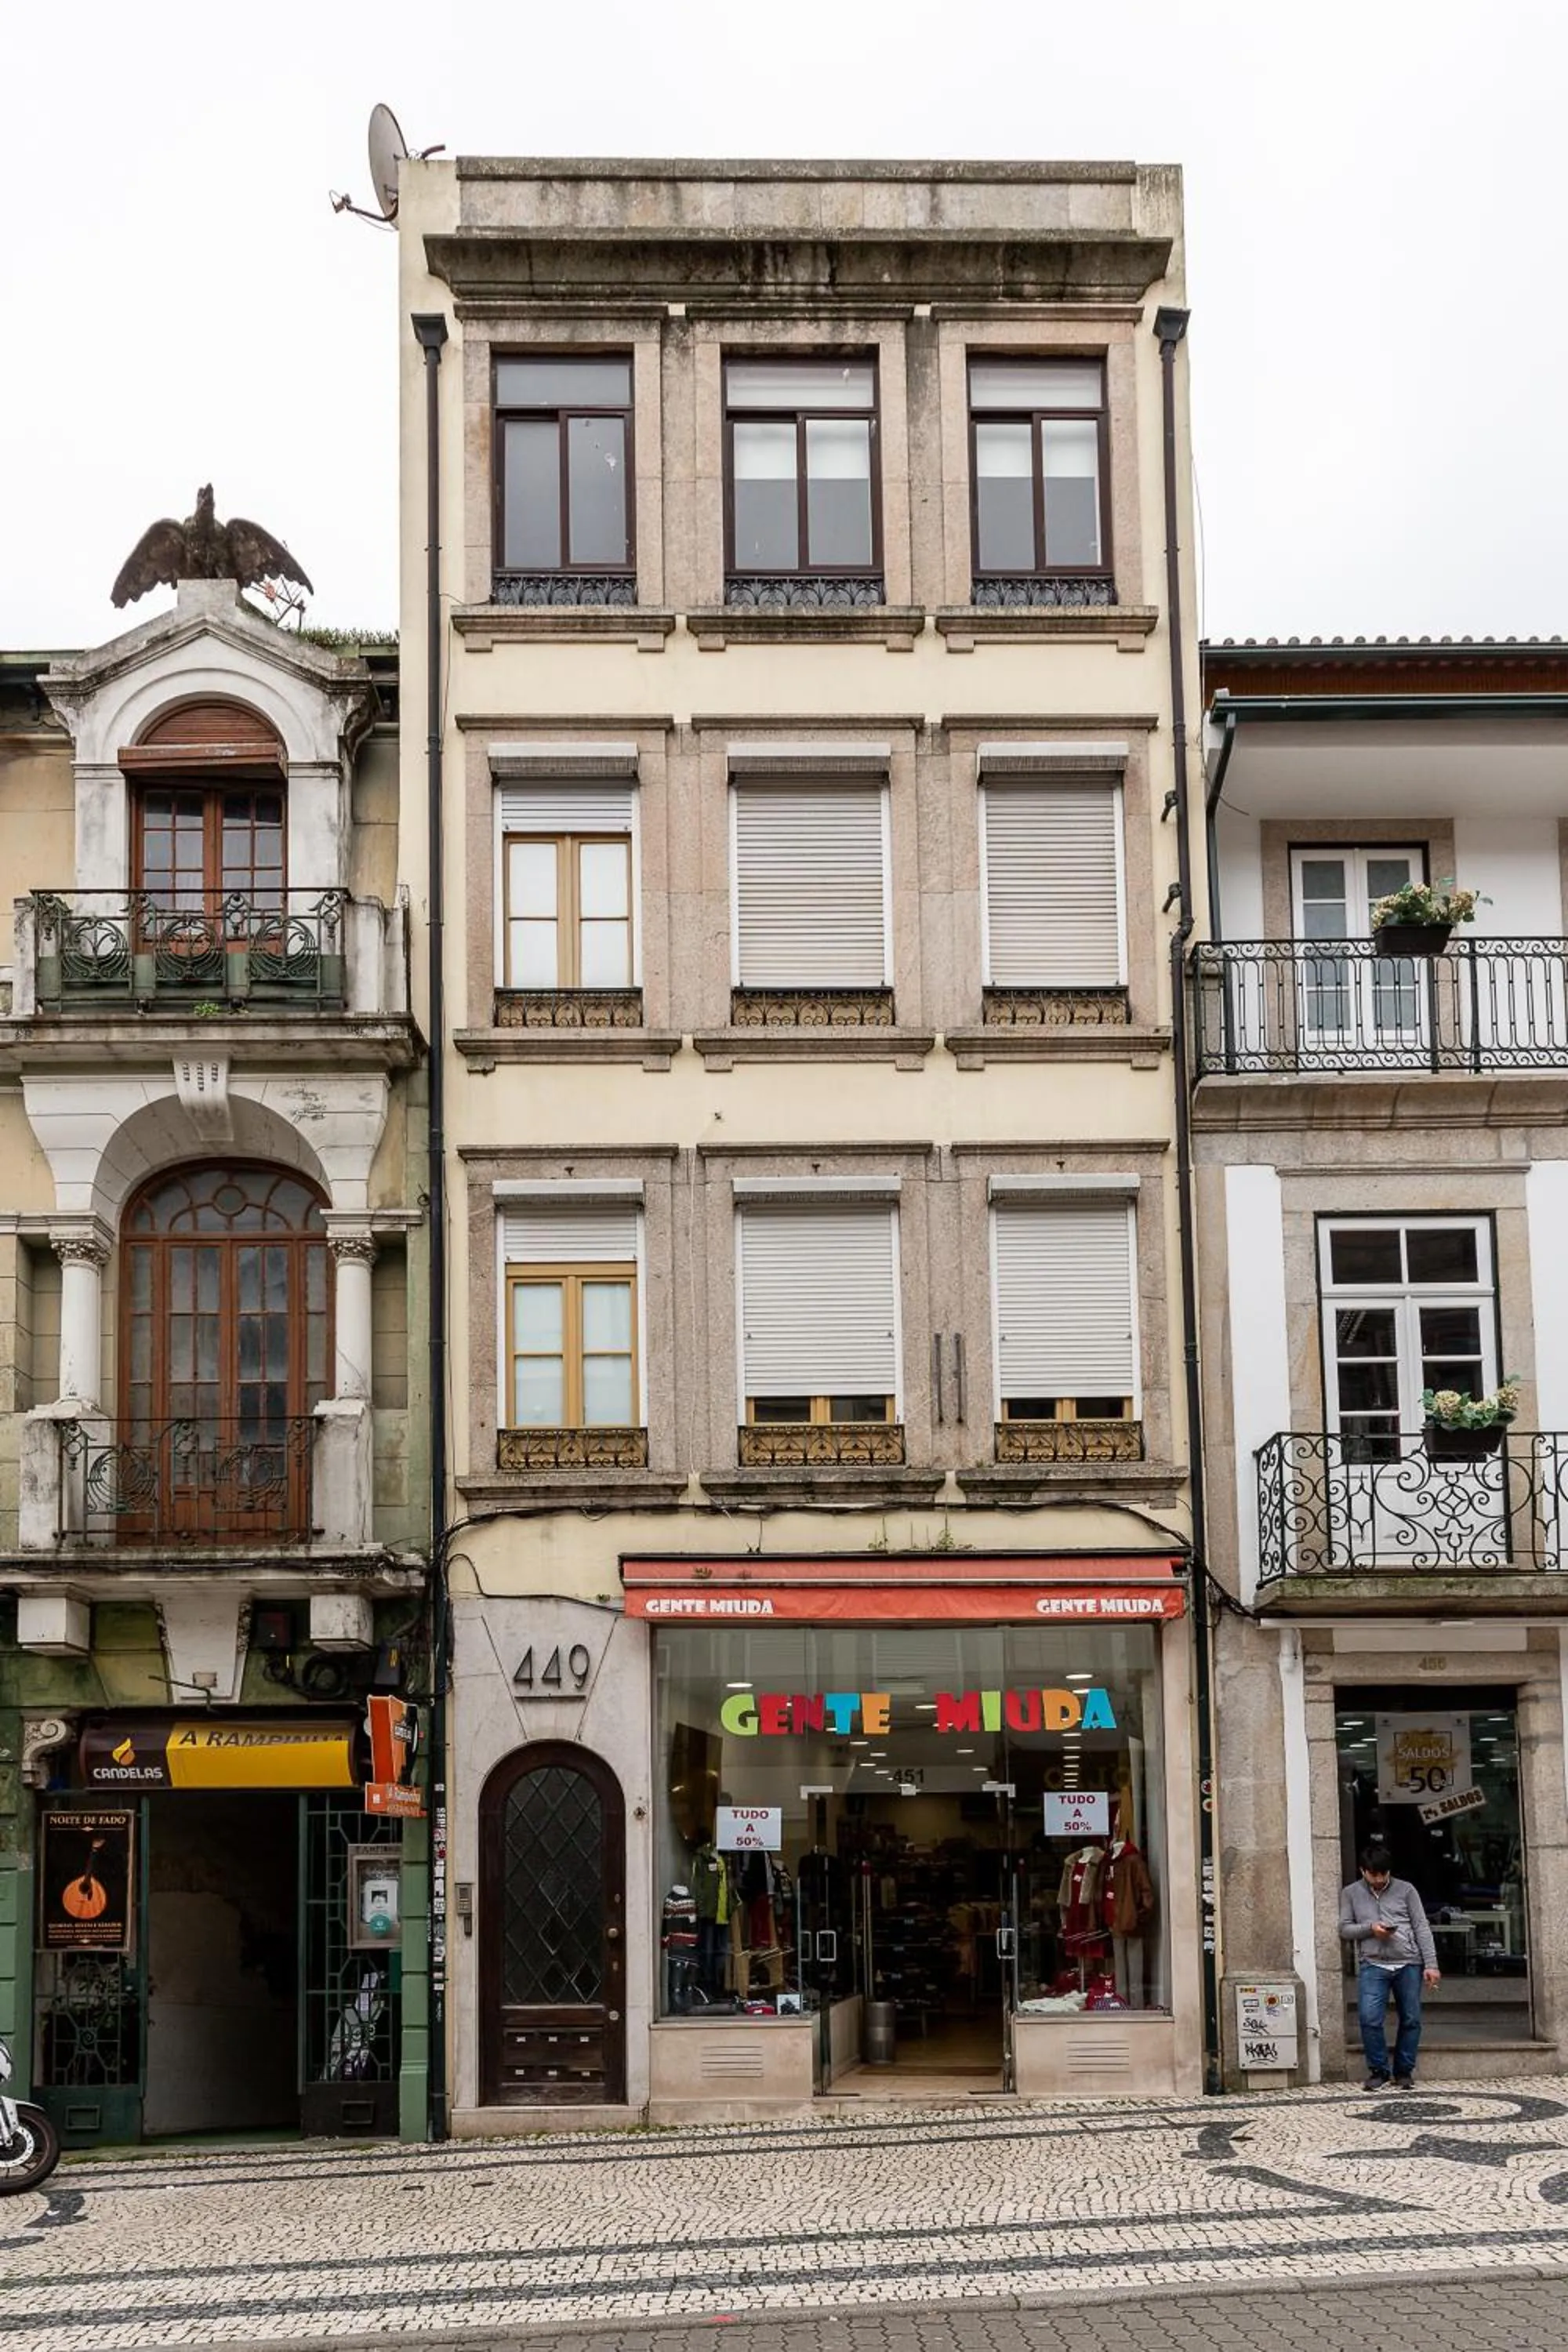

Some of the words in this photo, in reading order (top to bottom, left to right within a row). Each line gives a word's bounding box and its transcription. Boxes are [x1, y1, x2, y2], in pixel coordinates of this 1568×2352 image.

[645, 1599, 706, 1613] GENTE
[710, 1599, 774, 1614] MIUDA
[1036, 1598, 1097, 1613] GENTE
[1100, 1598, 1164, 1613] MIUDA
[513, 1644, 590, 1690] 449
[720, 1692, 891, 1736] GENTE
[935, 1688, 1117, 1733] MIUDA
[93, 1766, 163, 1780] CANDELAS
[894, 1769, 924, 1784] 451
[1058, 1795, 1095, 1805] TUDO
[1439, 1790, 1483, 1814] SALDOS
[732, 1809, 769, 1820] TUDO
[1073, 1808, 1082, 1818] A
[49, 1815, 82, 1824] NOITE
[83, 1815, 96, 1824] DE
[746, 1823, 755, 1832] A
[1064, 1821, 1091, 1831] 50%
[736, 1837, 764, 1846] 50%
